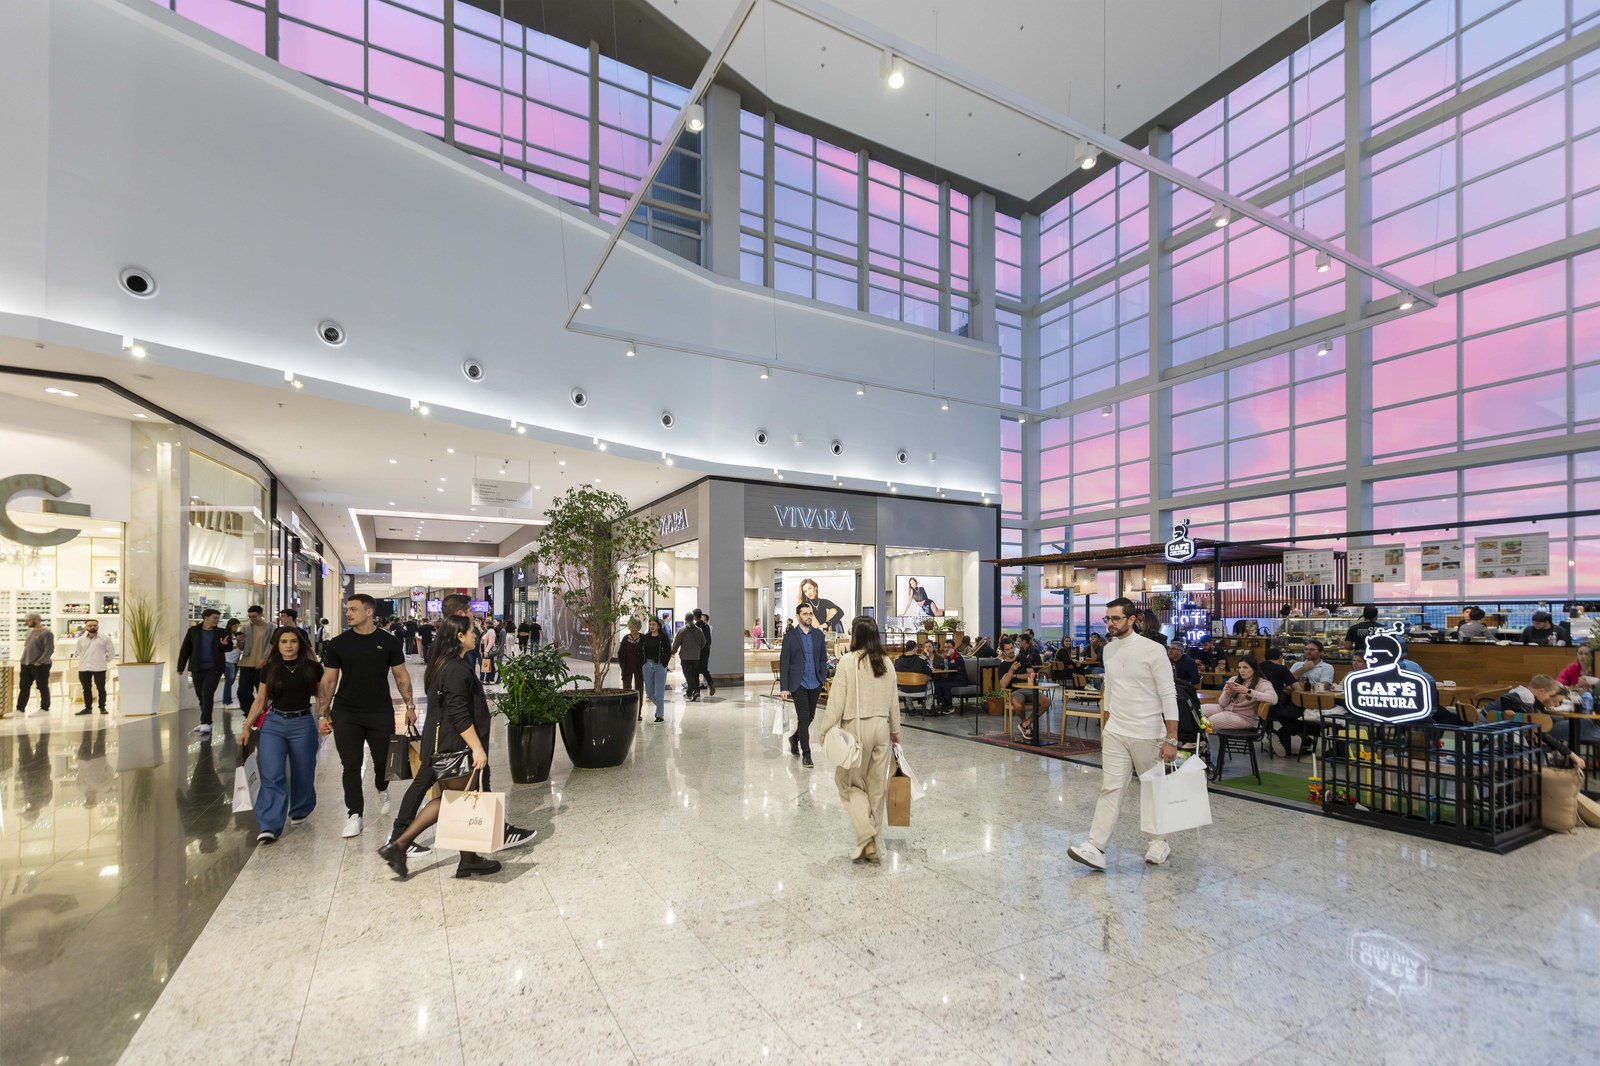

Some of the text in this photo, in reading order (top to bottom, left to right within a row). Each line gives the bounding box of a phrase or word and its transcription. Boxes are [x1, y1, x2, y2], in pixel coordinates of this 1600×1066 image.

[773, 505, 856, 531] VIVARA
[1357, 681, 1417, 697] CAFÉ
[1357, 695, 1418, 710] CULTURA
